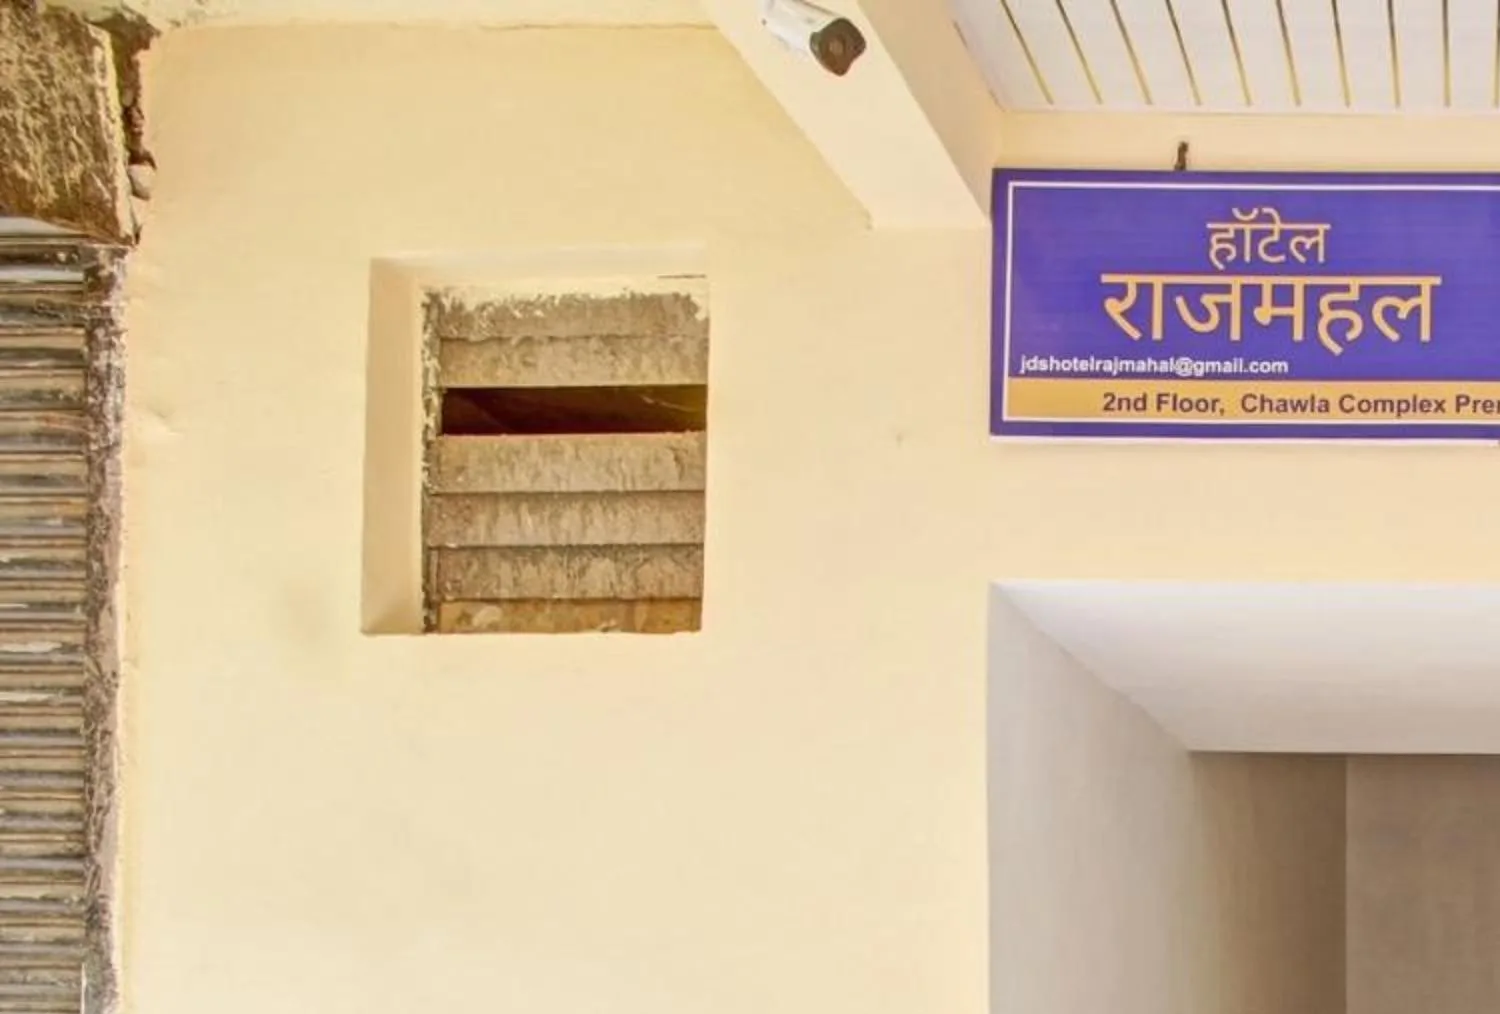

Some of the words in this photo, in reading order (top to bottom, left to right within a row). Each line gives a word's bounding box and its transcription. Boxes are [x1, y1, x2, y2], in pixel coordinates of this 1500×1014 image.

[1206, 207, 1331, 270] हॉटेल
[1100, 273, 1442, 356] राजमहल
[1019, 355, 1289, 375] jdshotelrajmahal@gmail.com
[1103, 392, 1148, 412] 2nd
[1156, 392, 1226, 416] Floor,
[1241, 393, 1330, 413] Chawla
[1338, 394, 1446, 418] Complex
